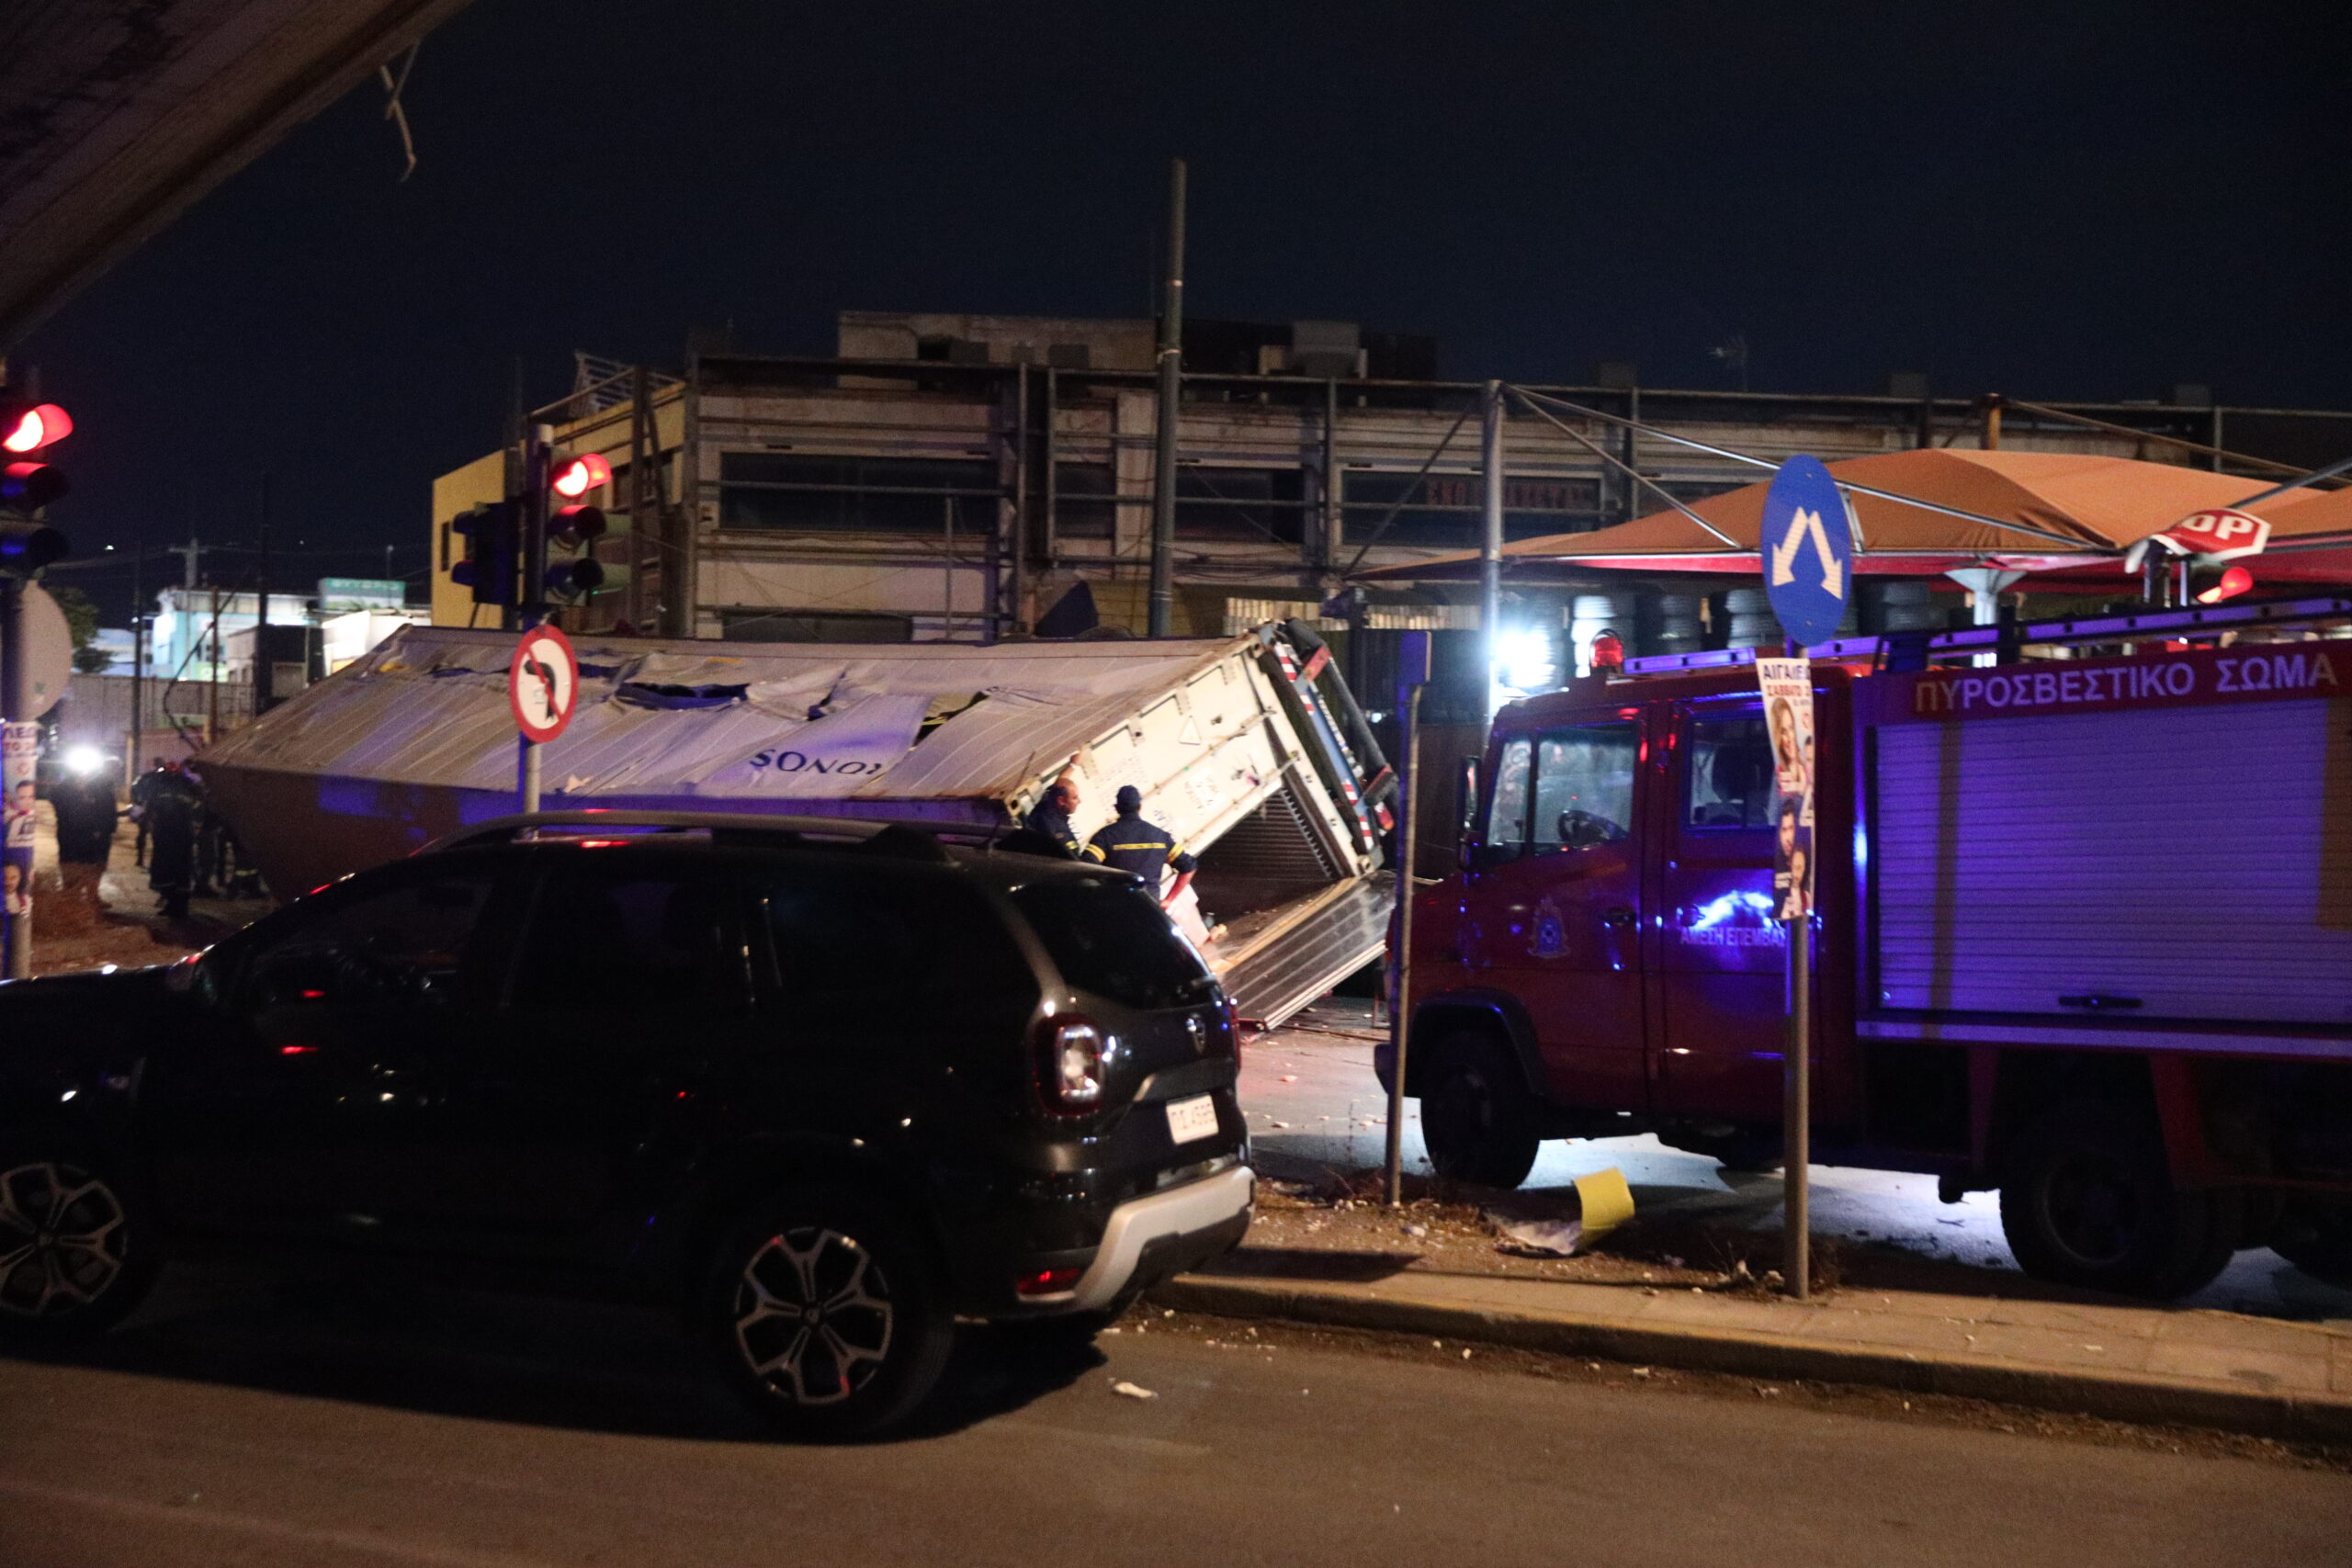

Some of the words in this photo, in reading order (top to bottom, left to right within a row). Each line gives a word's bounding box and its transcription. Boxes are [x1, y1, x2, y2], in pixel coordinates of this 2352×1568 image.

[2181, 514, 2255, 540] OP
[1915, 662, 2196, 712] ΠΥΡΟΣΒΕΣΤΙΚΟ
[2215, 652, 2338, 693] ΣΩΜΑ
